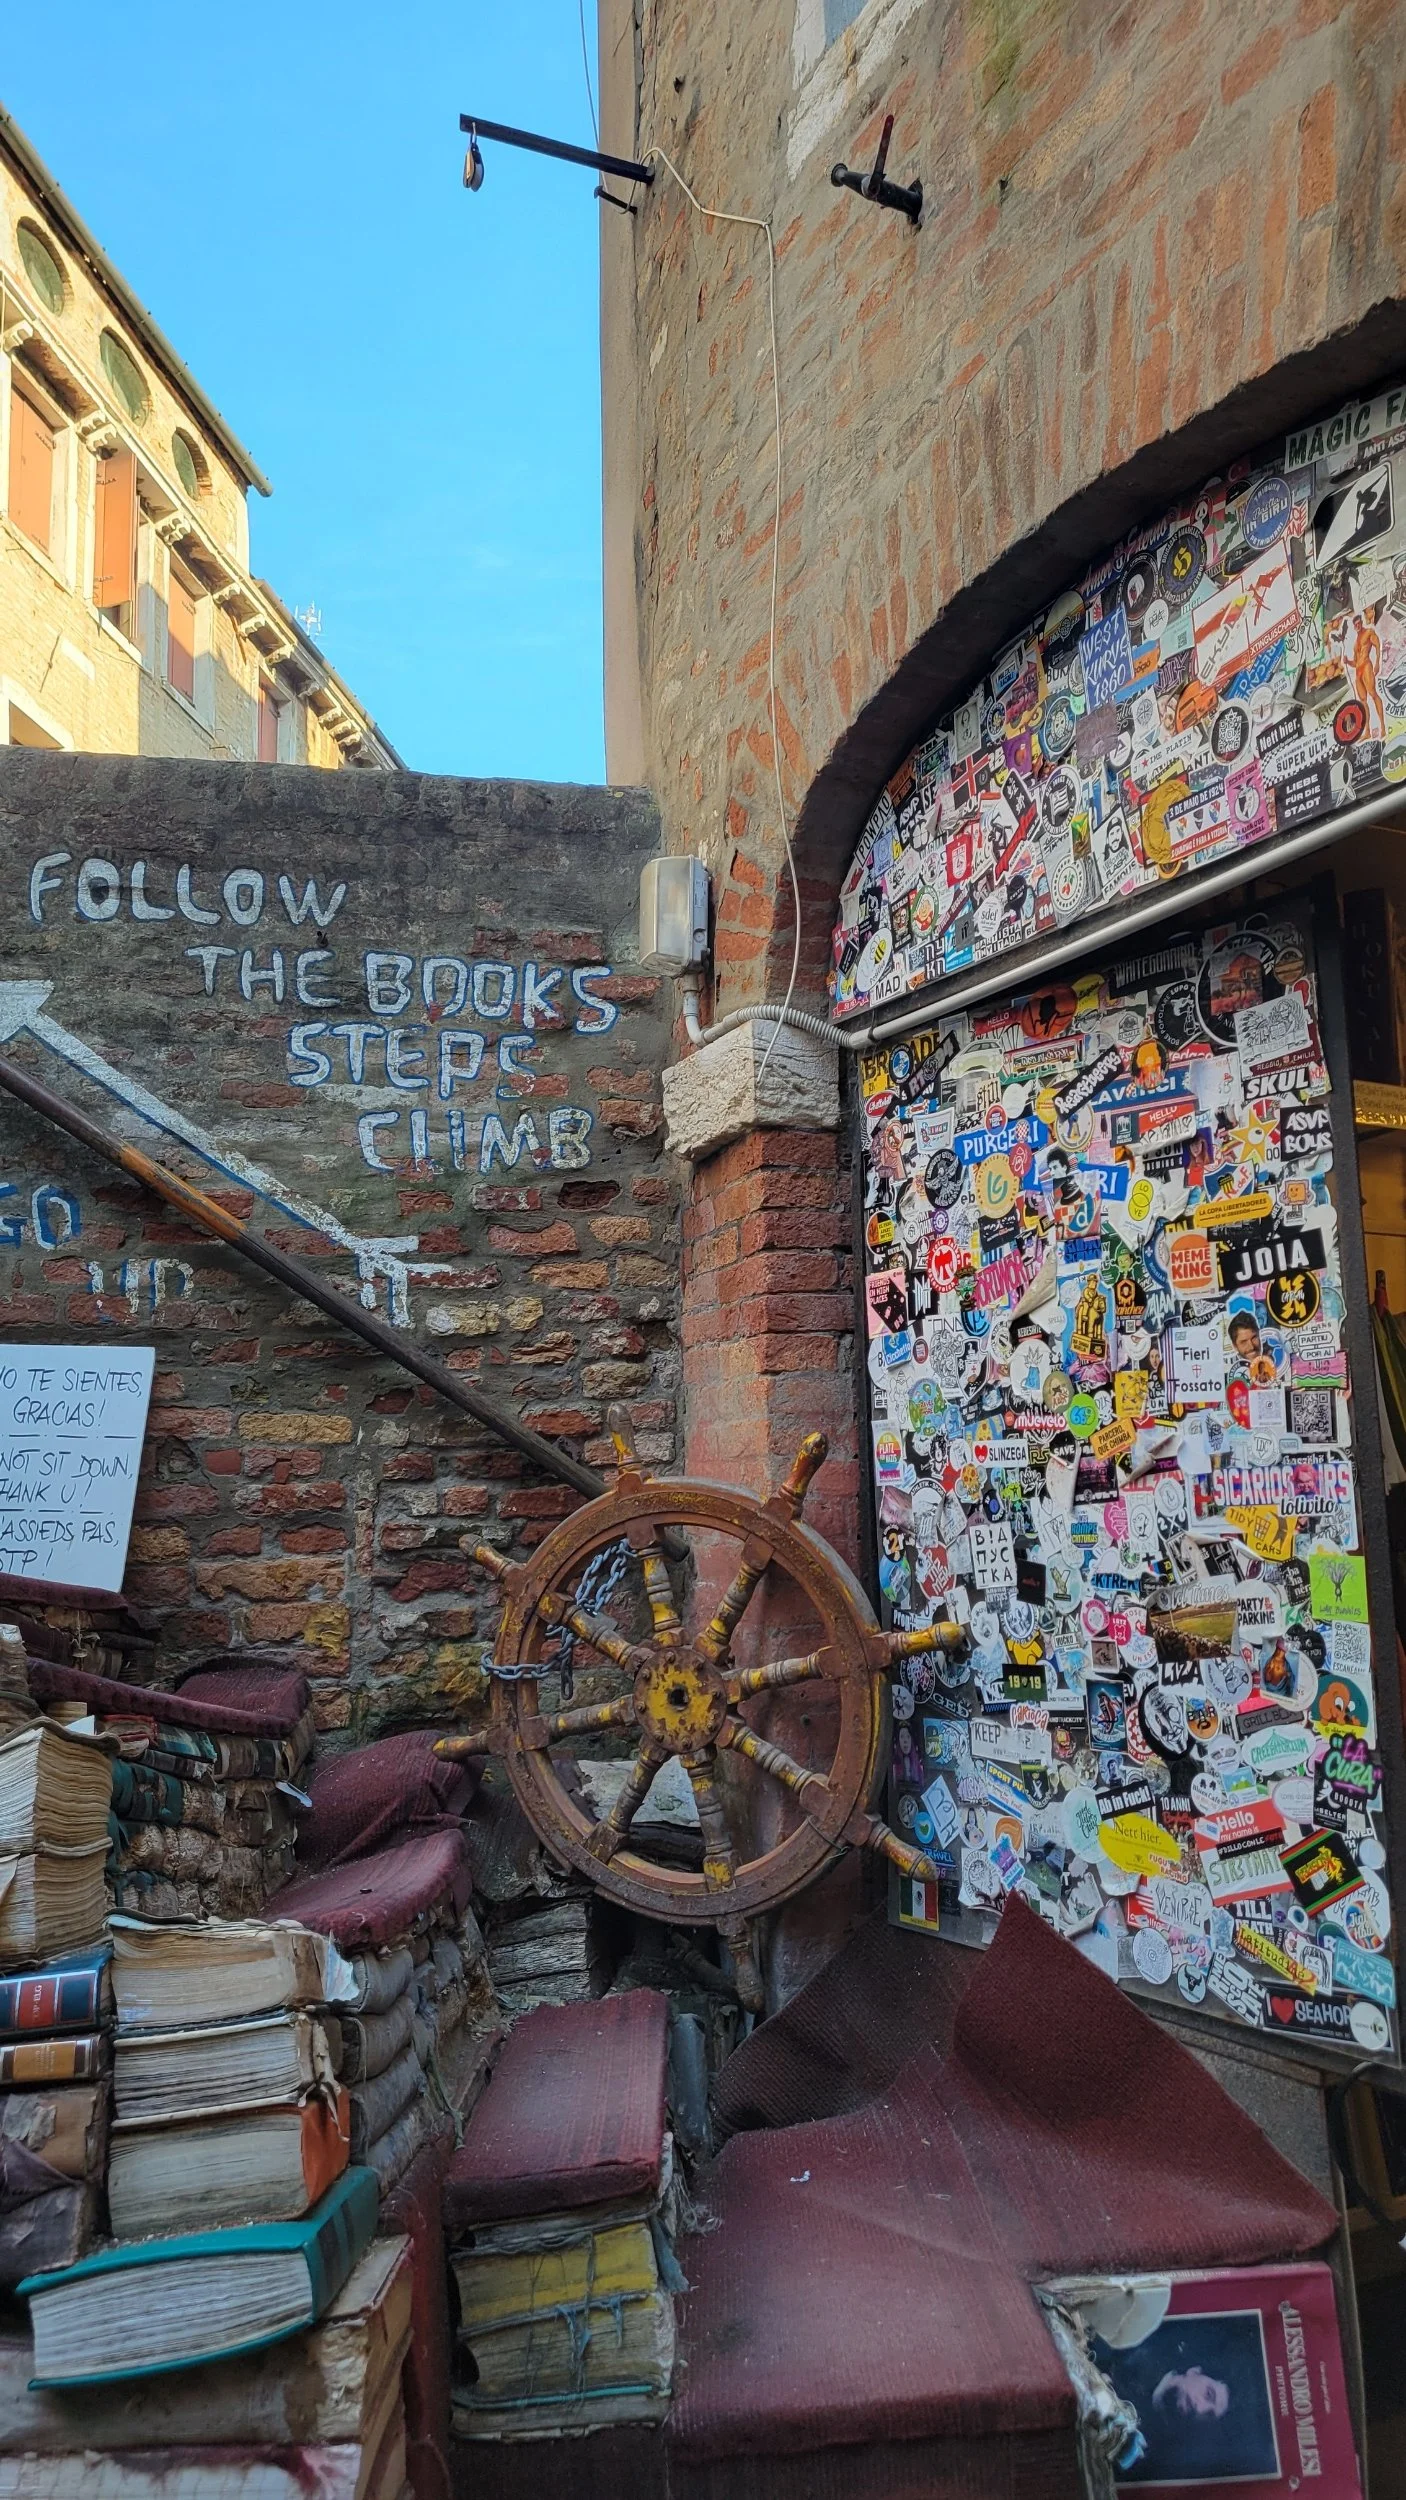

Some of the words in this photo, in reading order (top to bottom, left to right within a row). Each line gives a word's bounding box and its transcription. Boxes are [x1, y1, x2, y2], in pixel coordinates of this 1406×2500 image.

[1288, 403, 1371, 468] MAGIC
[1079, 607, 1122, 662] WEST
[1094, 662, 1127, 707] 1860
[1259, 726, 1280, 750] Nett
[1280, 718, 1300, 742] hier.
[1276, 752, 1305, 773] SUPER
[1309, 737, 1328, 760] ULM
[1285, 790, 1305, 806] FÜR
[1304, 784, 1322, 799] DIE
[1286, 773, 1319, 795] LIEBE
[1284, 797, 1322, 819] STADT
[28, 852, 348, 928] FOLLOW
[185, 945, 342, 1008] THE
[364, 950, 621, 1034] BOOKS
[875, 975, 901, 1001] MAD
[987, 1011, 1010, 1027] HELLO
[287, 1021, 537, 1100] STEPS
[357, 1107, 594, 1175] CLIMB
[962, 1118, 1040, 1161] PURGEI
[1207, 1205, 1223, 1216] COPA
[1223, 1197, 1267, 1212] LIBERTADORES
[1171, 1247, 1212, 1265] MEME
[1234, 1239, 1310, 1282] JOIA
[1171, 1261, 1213, 1281] KING
[1300, 1334, 1328, 1344] PARTIU
[1175, 1346, 1210, 1361] Fieri
[27, 1368, 56, 1392] TE
[62, 1367, 143, 1398] SIENTES,
[1167, 1378, 1222, 1393] Fossato
[13, 1395, 107, 1428] GRACIAS!
[989, 1446, 1027, 1461] SLINZEGA
[1053, 1444, 1075, 1457] SAVE
[39, 1450, 72, 1477] SIT
[71, 1453, 134, 1481] DOWN,
[1230, 1508, 1255, 1528] TIDY
[82, 1519, 120, 1548] PAS,
[1255, 1541, 1282, 1555] CARS
[1237, 1598, 1264, 1612] PARTY
[1237, 1610, 1276, 1627] PARKING
[1008, 1675, 1021, 1689] 19
[1029, 1675, 1041, 1689] 19
[974, 1722, 1000, 1745] KEEP
[1124, 1787, 1151, 1809] Fuck!
[1161, 1796, 1169, 1809] 10
[1169, 1797, 1191, 1812] ANNI
[1216, 1811, 1255, 1833] Hello
[1113, 1822, 1138, 1838] Nett
[1139, 1826, 1163, 1846] hier.
[1220, 1833, 1231, 1844] my
[1231, 1829, 1252, 1841] name
